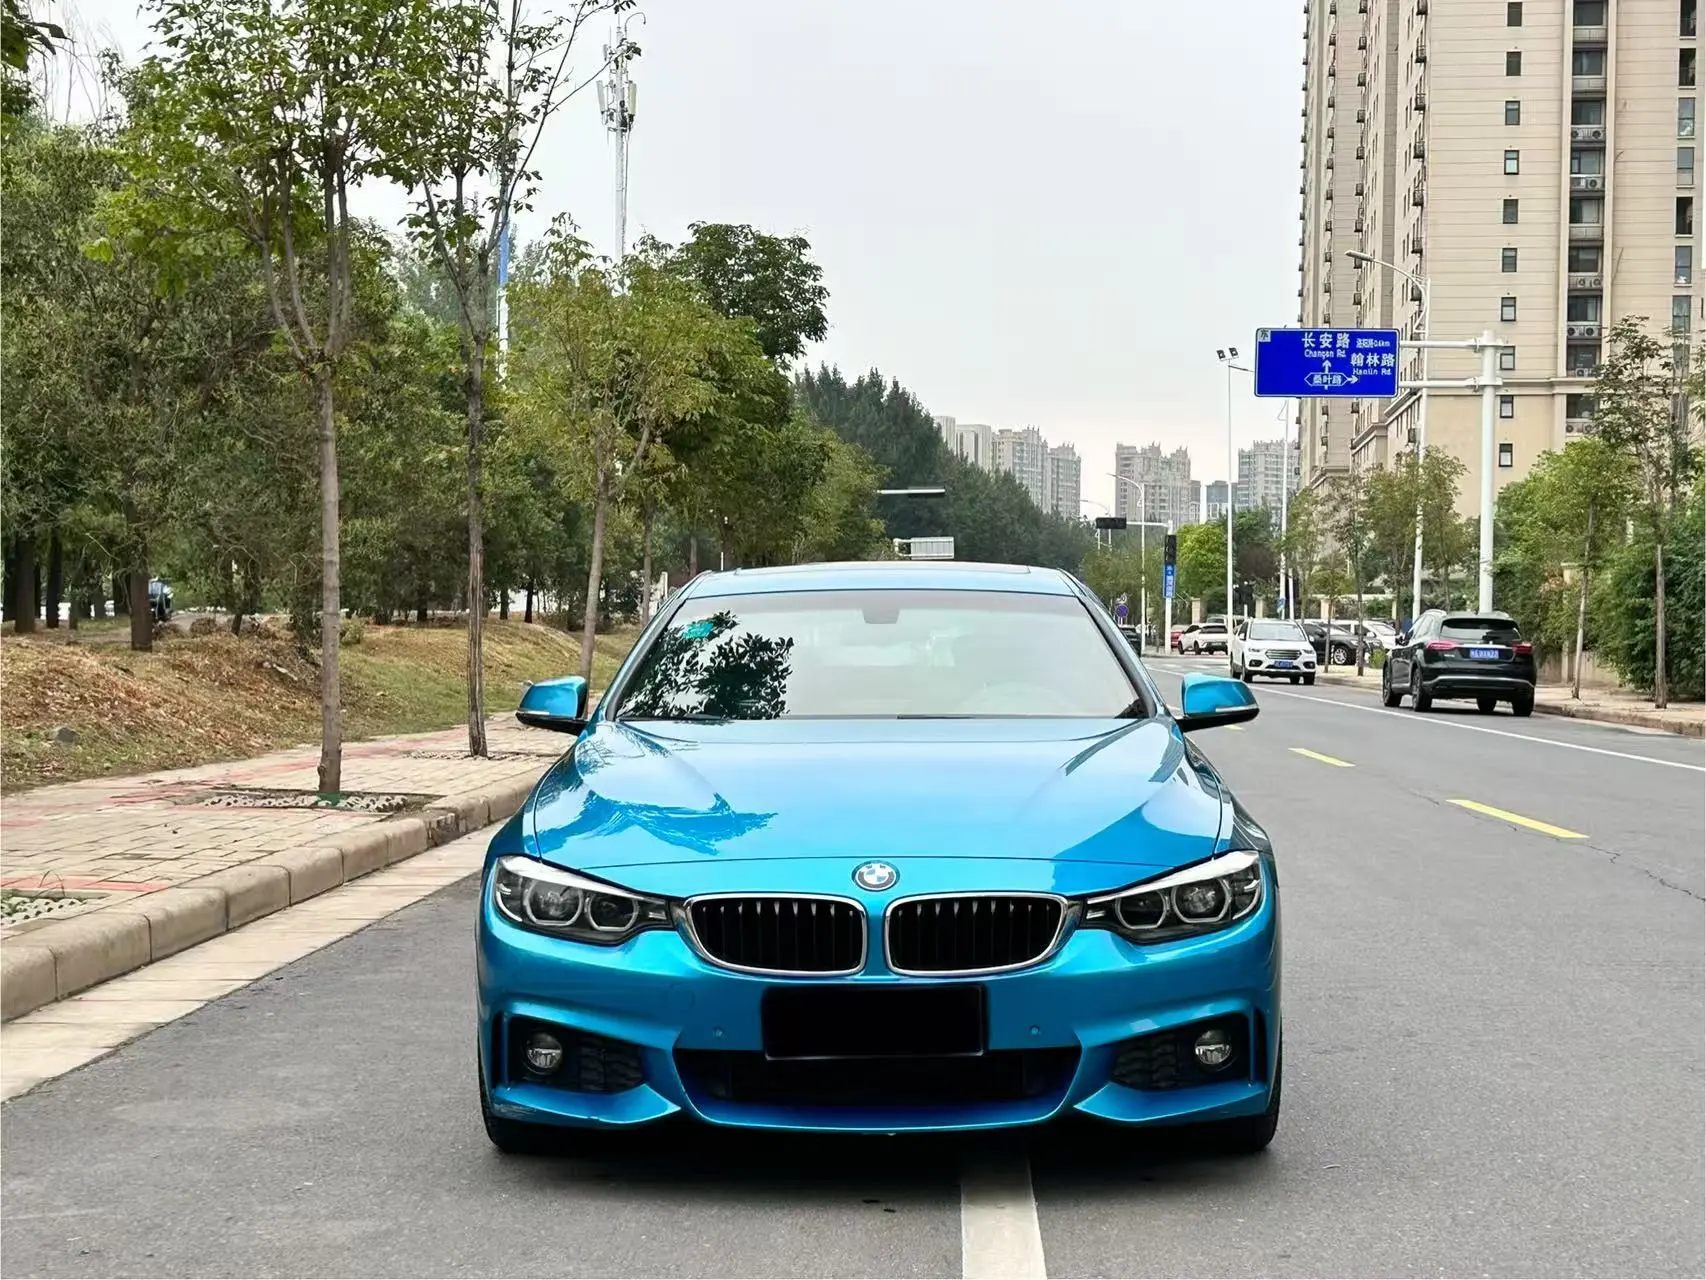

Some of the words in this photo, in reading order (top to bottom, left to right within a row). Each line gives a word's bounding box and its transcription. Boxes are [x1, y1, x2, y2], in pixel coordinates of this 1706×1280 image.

[1302, 332, 1350, 348] 长安路
[1304, 349, 1334, 359] Changan
[1351, 353, 1395, 367] 翰林路
